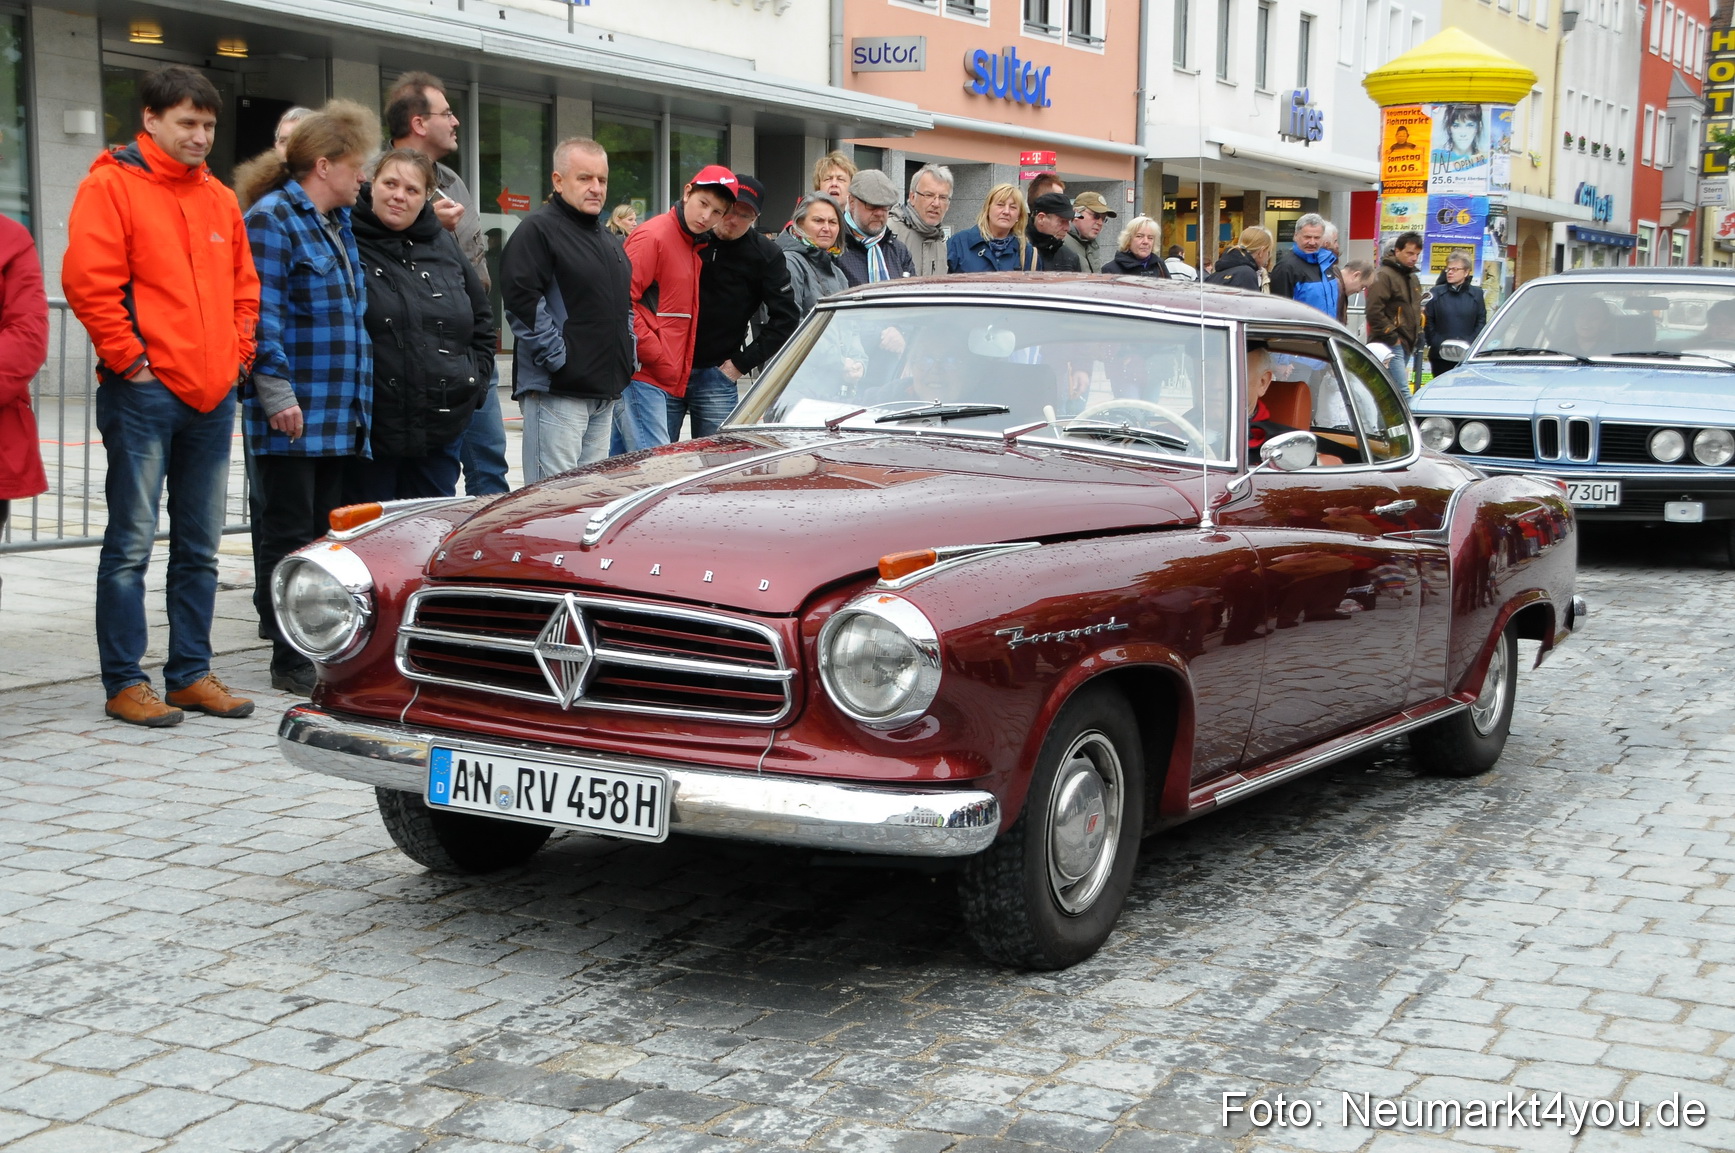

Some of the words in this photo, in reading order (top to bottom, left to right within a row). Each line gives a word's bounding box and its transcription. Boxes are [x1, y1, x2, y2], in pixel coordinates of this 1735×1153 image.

[1703, 29, 1735, 173] HOTEL
[1386, 117, 1429, 125] Flohmarkt
[1387, 154, 1421, 162] Samstag
[1432, 151, 1453, 175] ZAZ
[1454, 158, 1474, 172] OPEN
[1387, 164, 1419, 173] 01.06.
[1432, 175, 1455, 185] 25.6.
[738, 184, 759, 198] ONDA
[1267, 199, 1301, 209] FRIES
[1568, 484, 1617, 501] 730H
[436, 549, 770, 592] BORGWARD
[435, 781, 445, 794] D
[452, 758, 493, 804] AN
[516, 767, 558, 813] RV
[567, 775, 657, 828] 458H
